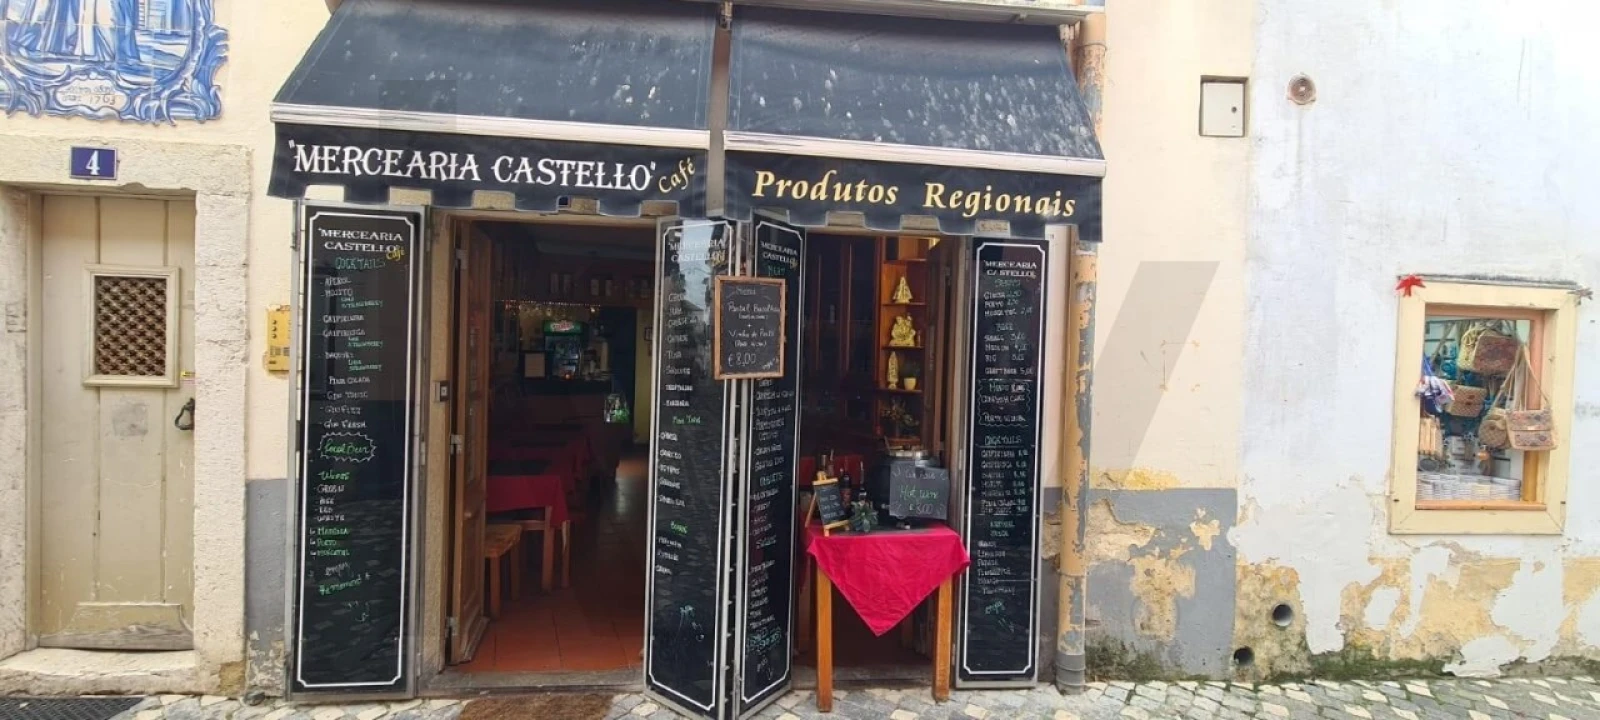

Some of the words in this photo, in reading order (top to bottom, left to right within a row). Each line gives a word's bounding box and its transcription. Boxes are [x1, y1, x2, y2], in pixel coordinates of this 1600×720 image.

[85, 149, 101, 175] 4
[658, 157, 696, 194] Café
[752, 169, 898, 205] Produtos
[923, 182, 1077, 218] Regionais
